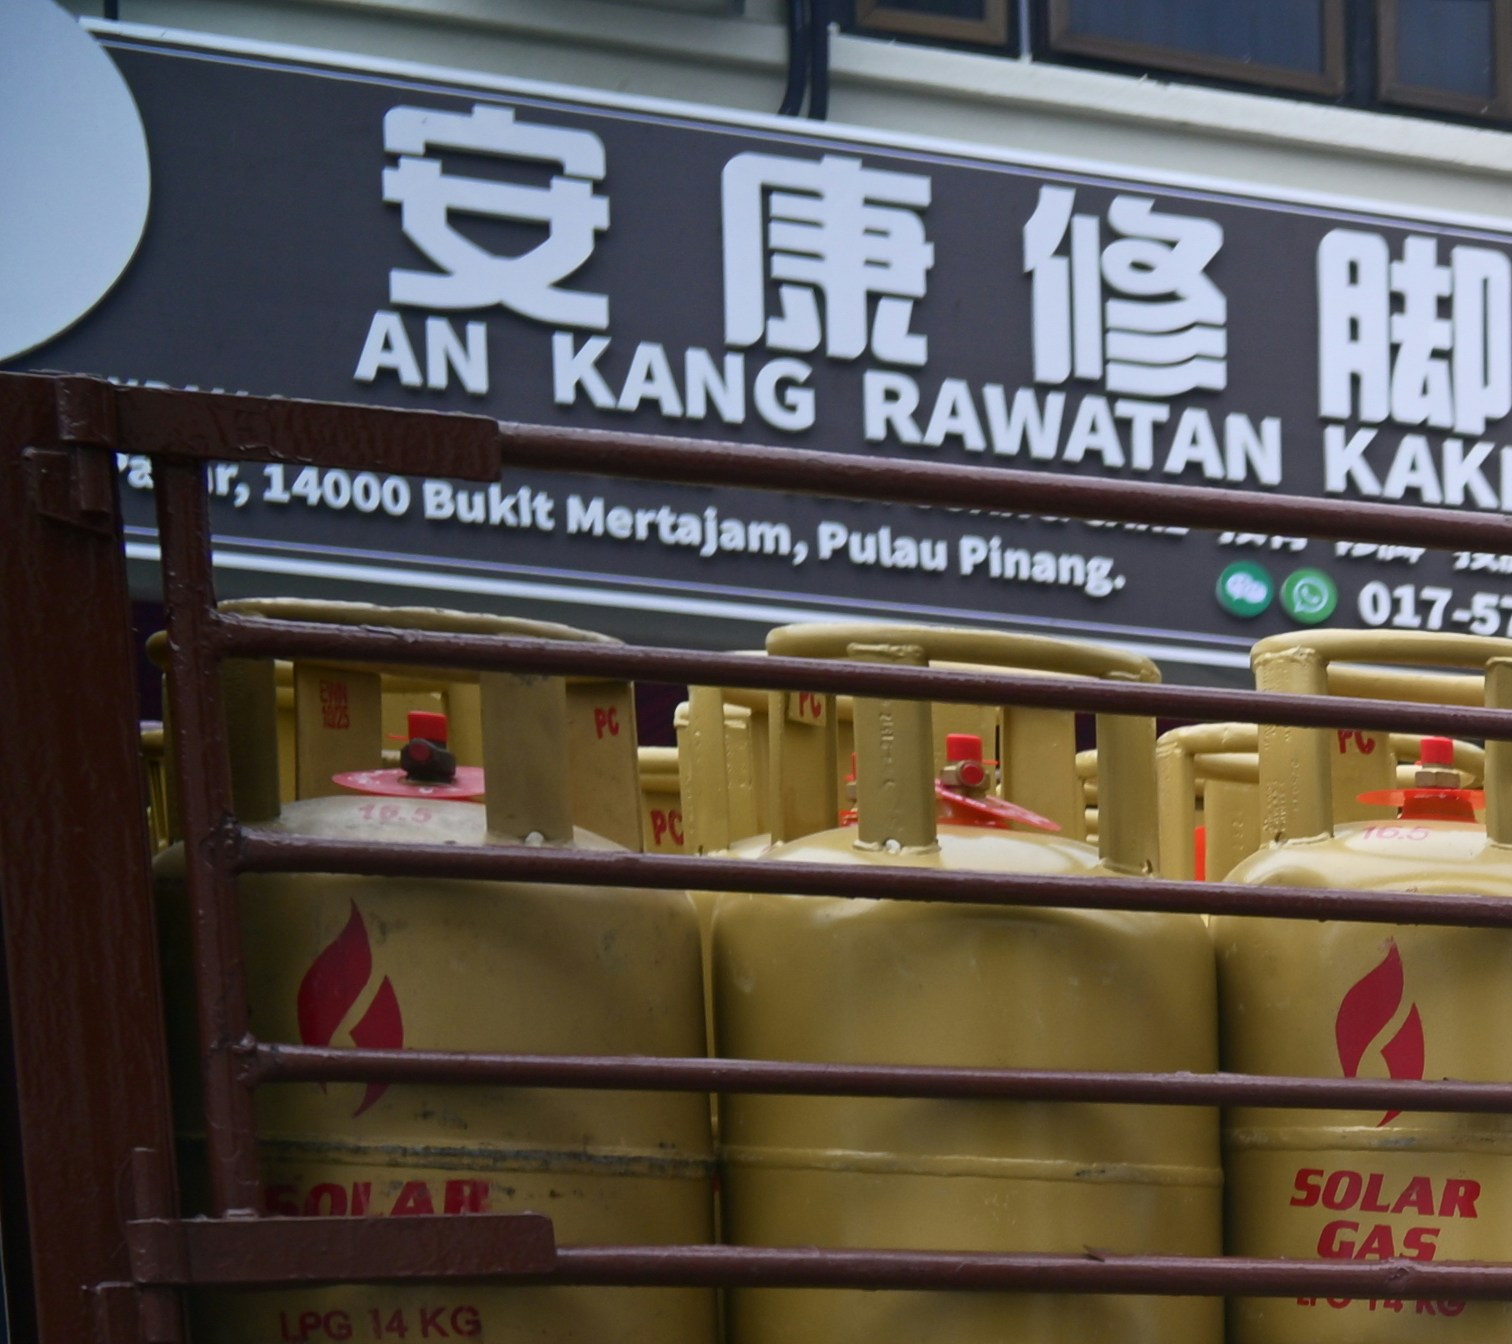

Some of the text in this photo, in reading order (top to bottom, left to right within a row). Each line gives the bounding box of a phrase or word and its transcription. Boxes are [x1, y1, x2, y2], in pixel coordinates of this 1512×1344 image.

[353, 309, 490, 395] AN
[551, 331, 816, 432] KANG
[862, 369, 1283, 487] RAWATAN
[262, 462, 411, 517] 14000
[422, 478, 556, 532] Bukit
[565, 494, 809, 568] Mertajam,
[818, 520, 948, 574] Pulau
[958, 536, 1127, 599] Pinang.
[594, 705, 620, 739] PC
[1361, 825, 1430, 841] 16.5
[1289, 1167, 1482, 1219] SOLAR
[1316, 1219, 1441, 1262] GAS
[280, 1305, 483, 1343] LPG 14 KG
